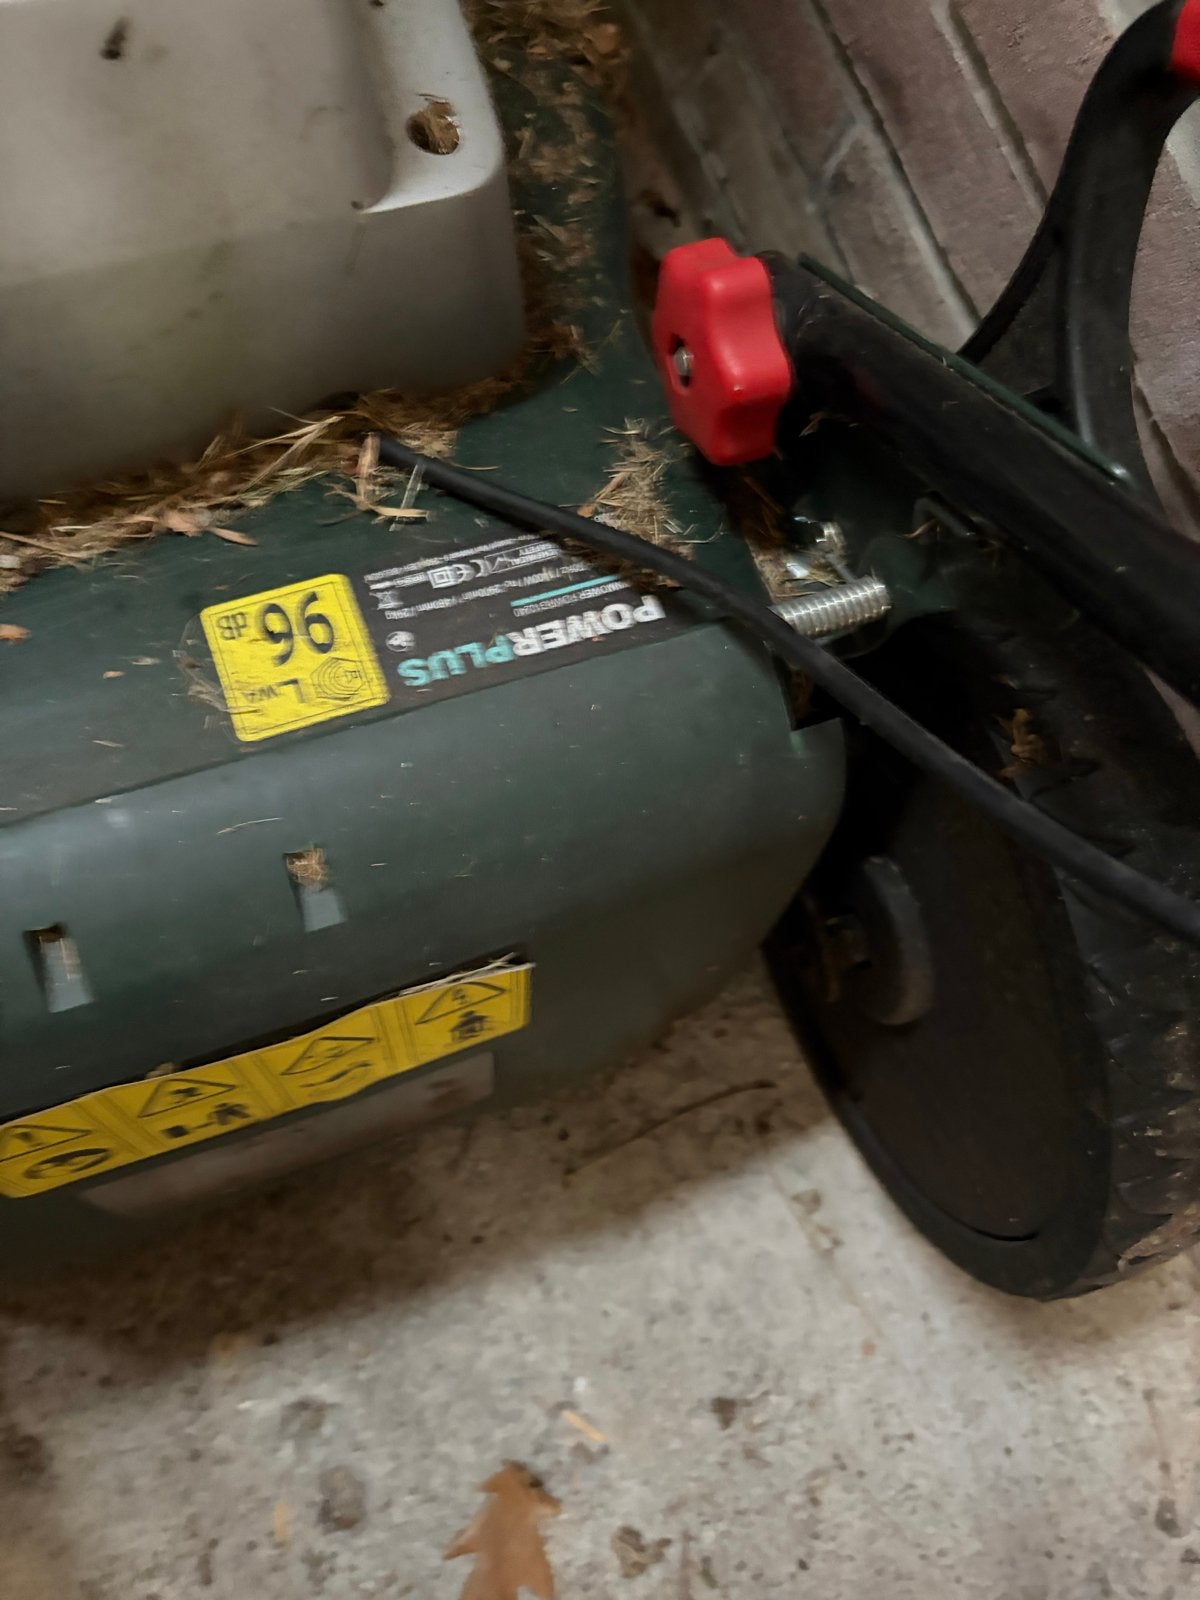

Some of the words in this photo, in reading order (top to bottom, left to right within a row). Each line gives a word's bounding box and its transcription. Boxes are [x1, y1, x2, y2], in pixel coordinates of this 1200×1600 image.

[216, 612, 247, 640] dB
[255, 591, 335, 667] 96
[398, 594, 667, 687] POWERPLUS
